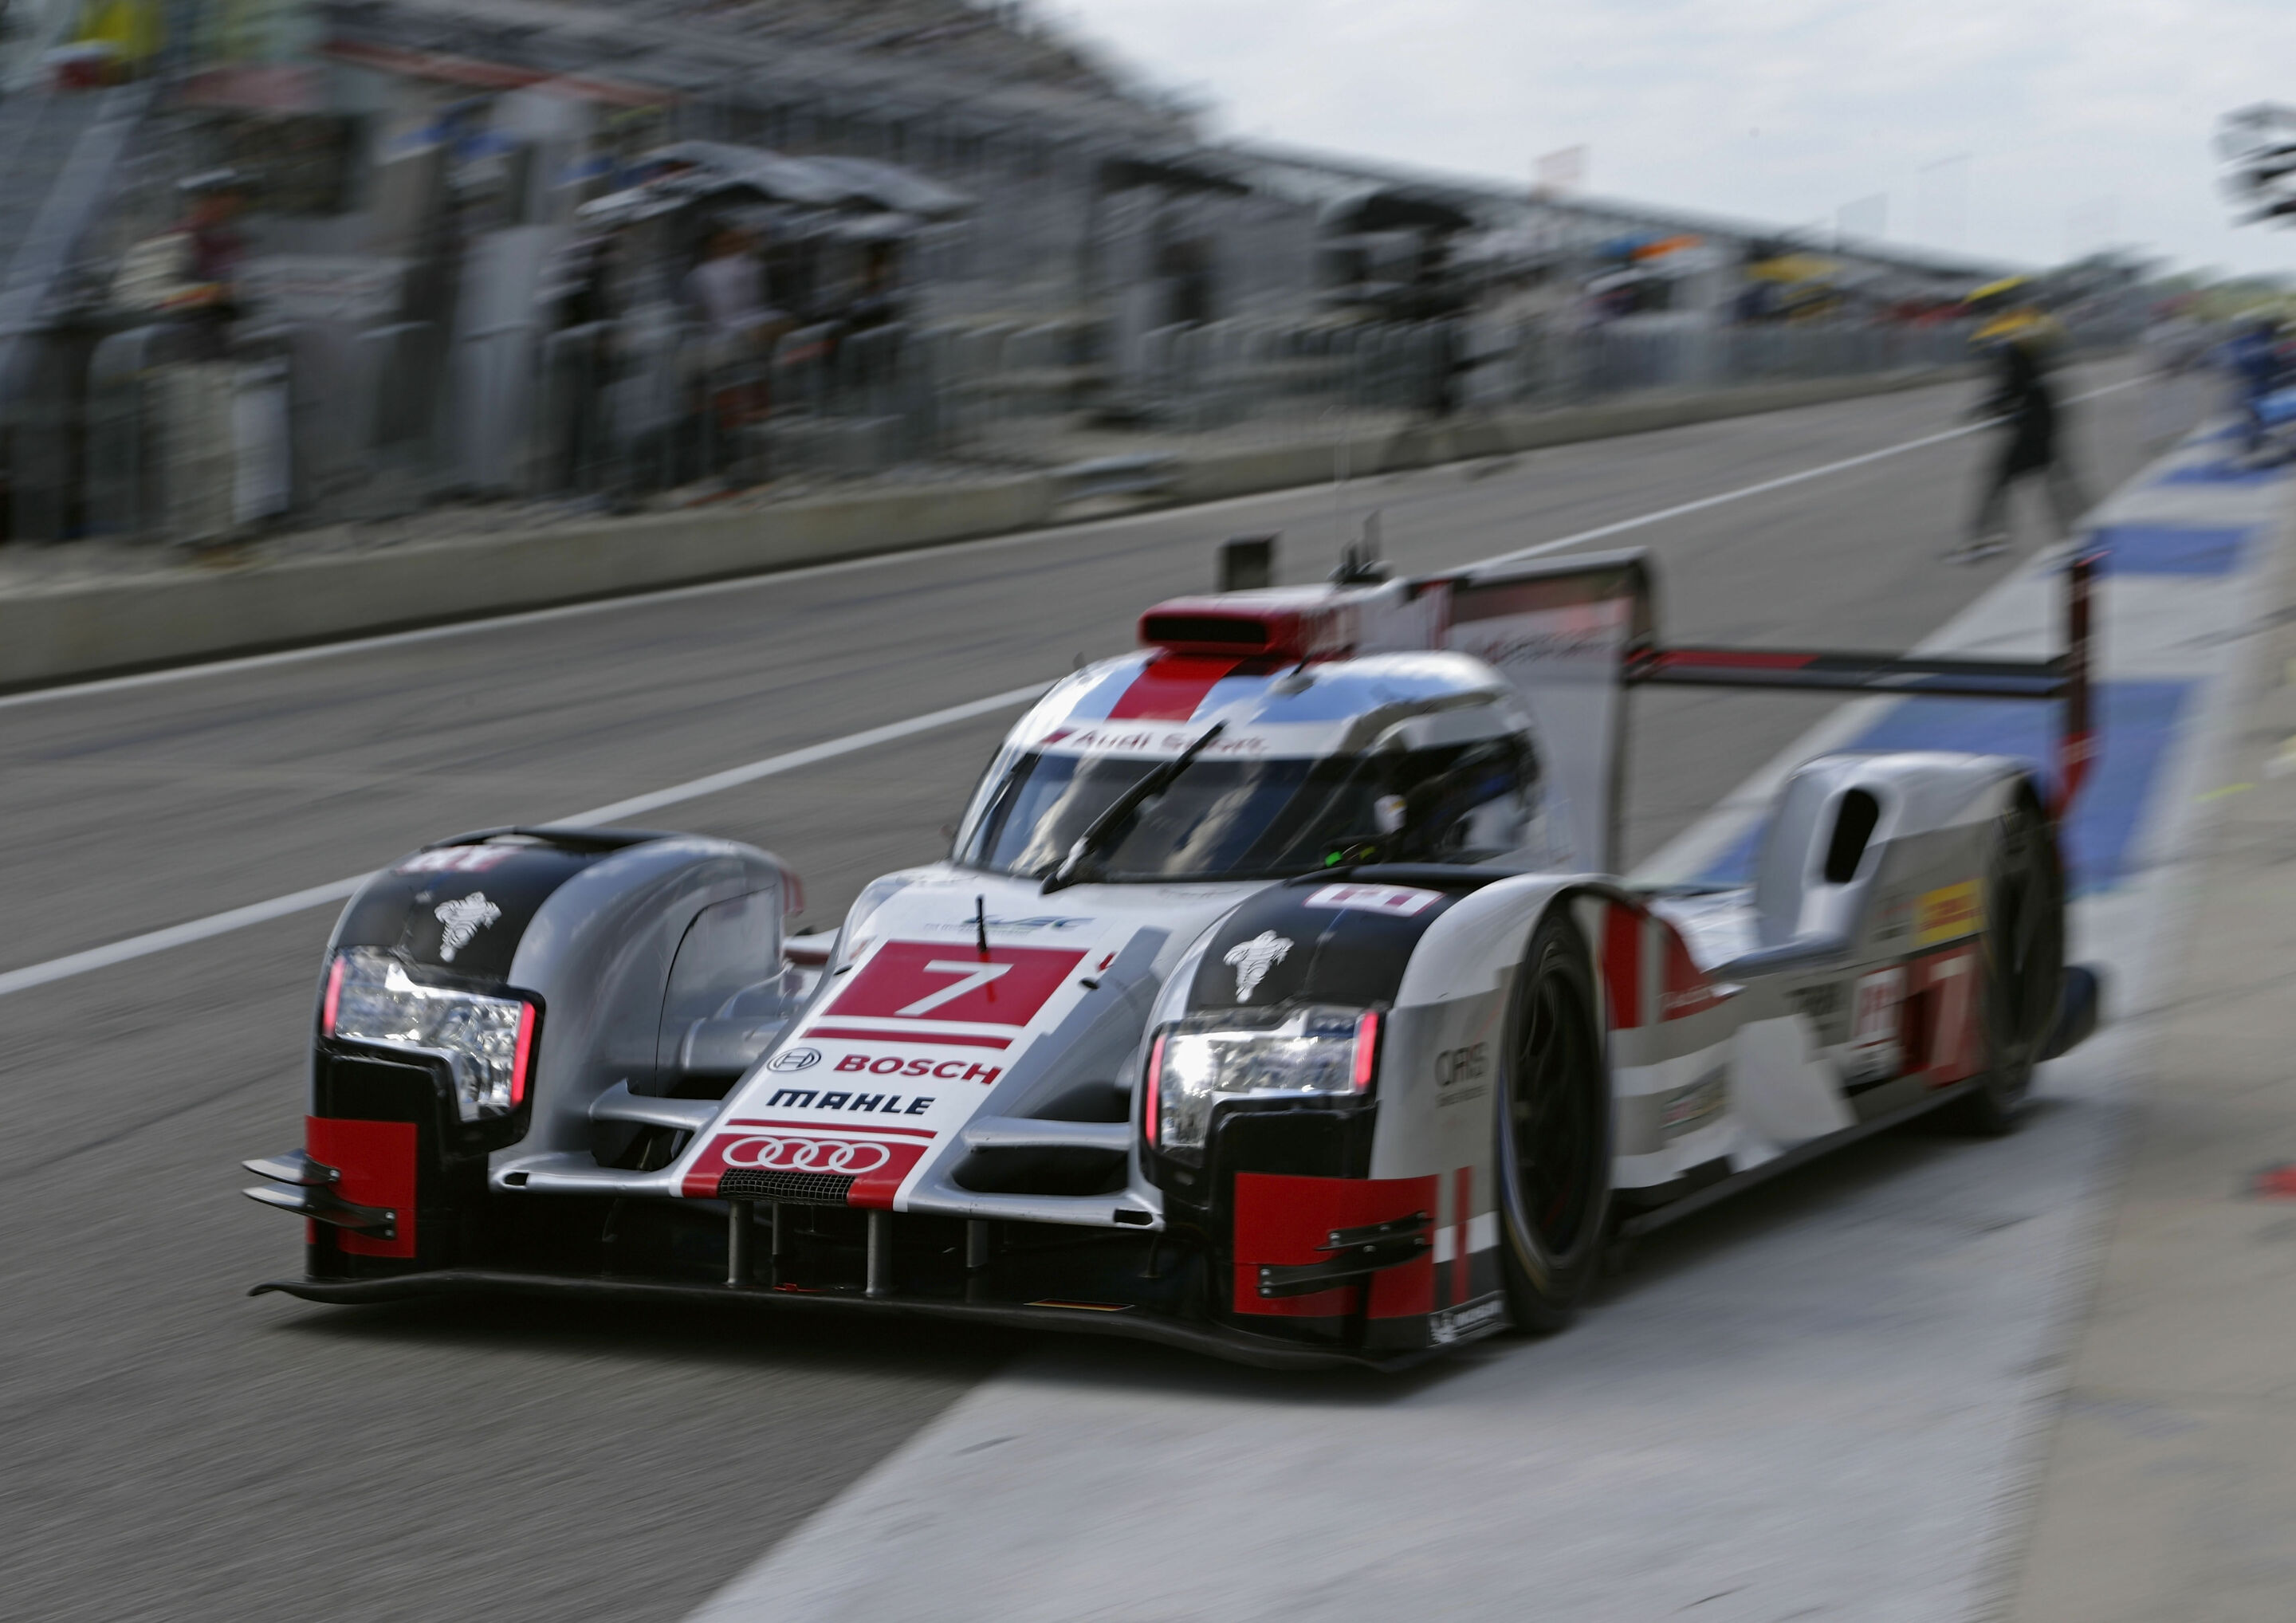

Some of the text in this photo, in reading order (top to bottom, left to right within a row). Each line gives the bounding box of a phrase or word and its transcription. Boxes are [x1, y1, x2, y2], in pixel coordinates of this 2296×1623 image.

[1074, 729, 1154, 752] Audi
[894, 959, 1015, 1017] 7
[832, 1054, 1004, 1087] BOSCH
[765, 1088, 937, 1116] MAHLE
